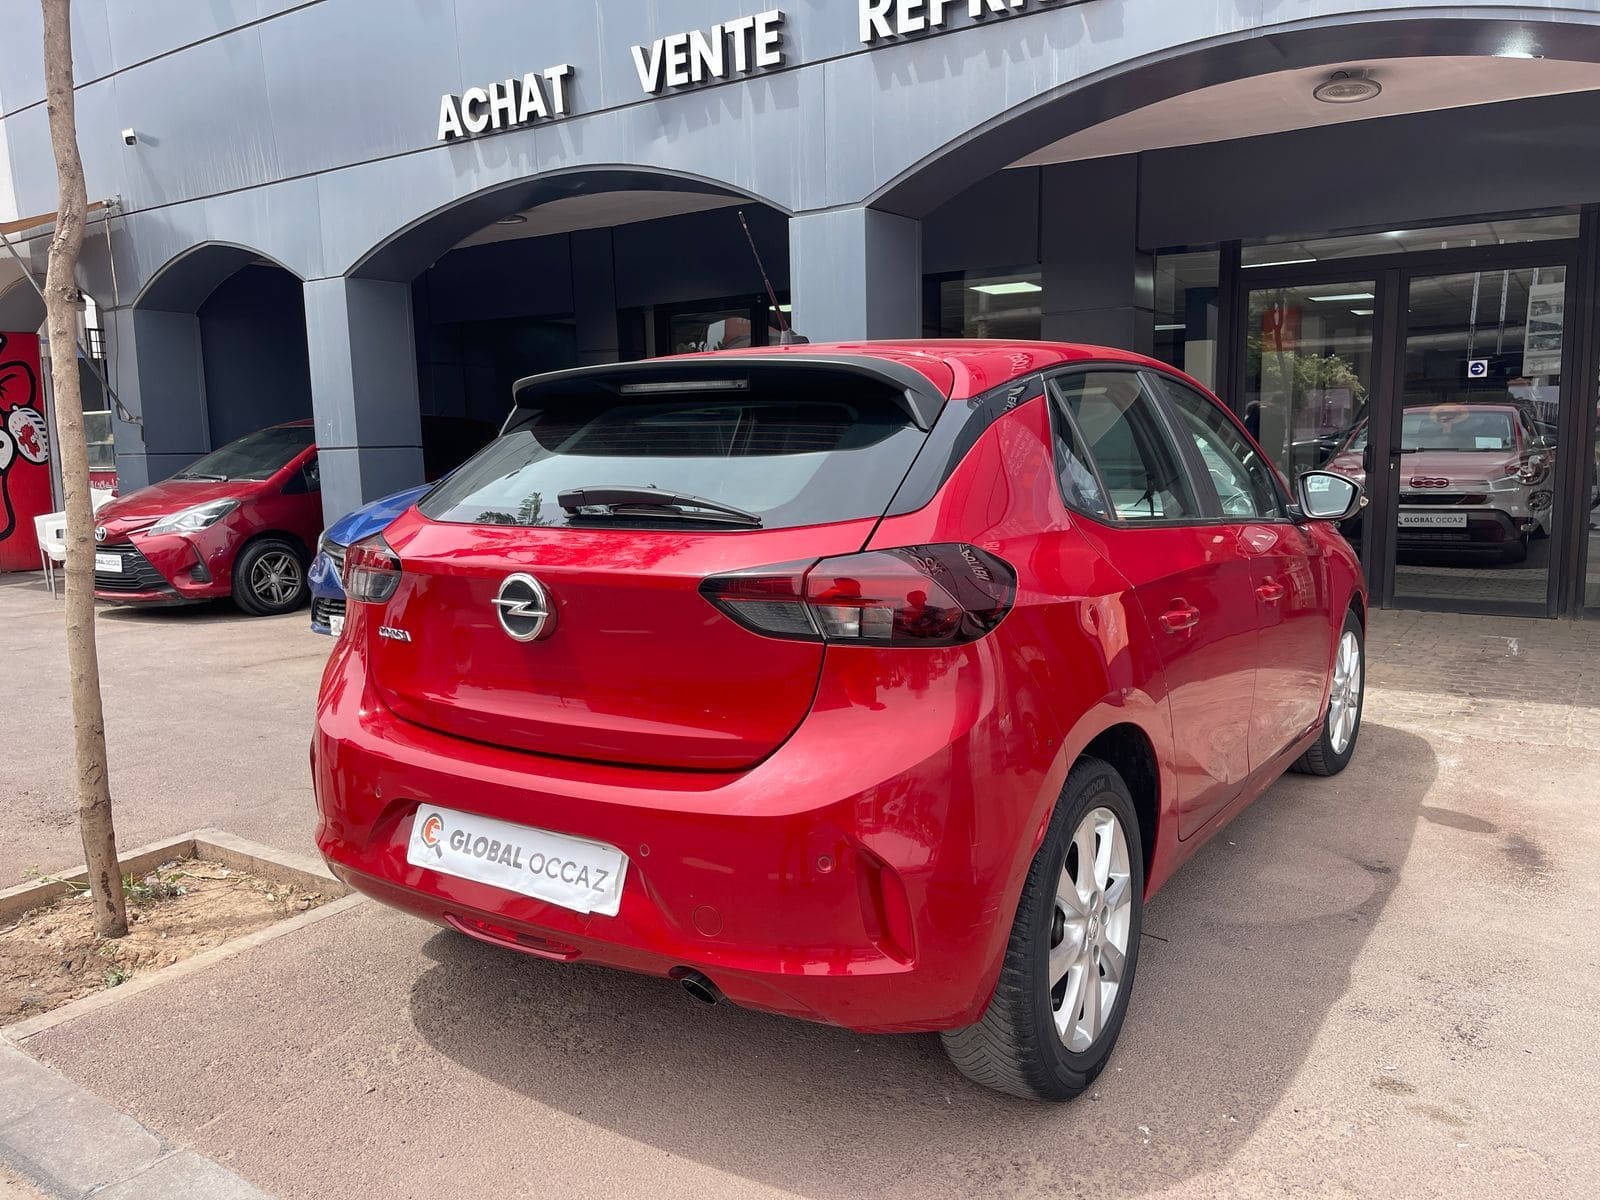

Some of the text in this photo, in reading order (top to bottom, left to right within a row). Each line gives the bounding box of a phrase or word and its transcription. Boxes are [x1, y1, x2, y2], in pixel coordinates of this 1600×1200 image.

[437, 63, 574, 141] ACHAT
[630, 9, 786, 95] VENTE
[450, 829, 609, 893] GLOBAL OCCAZ
